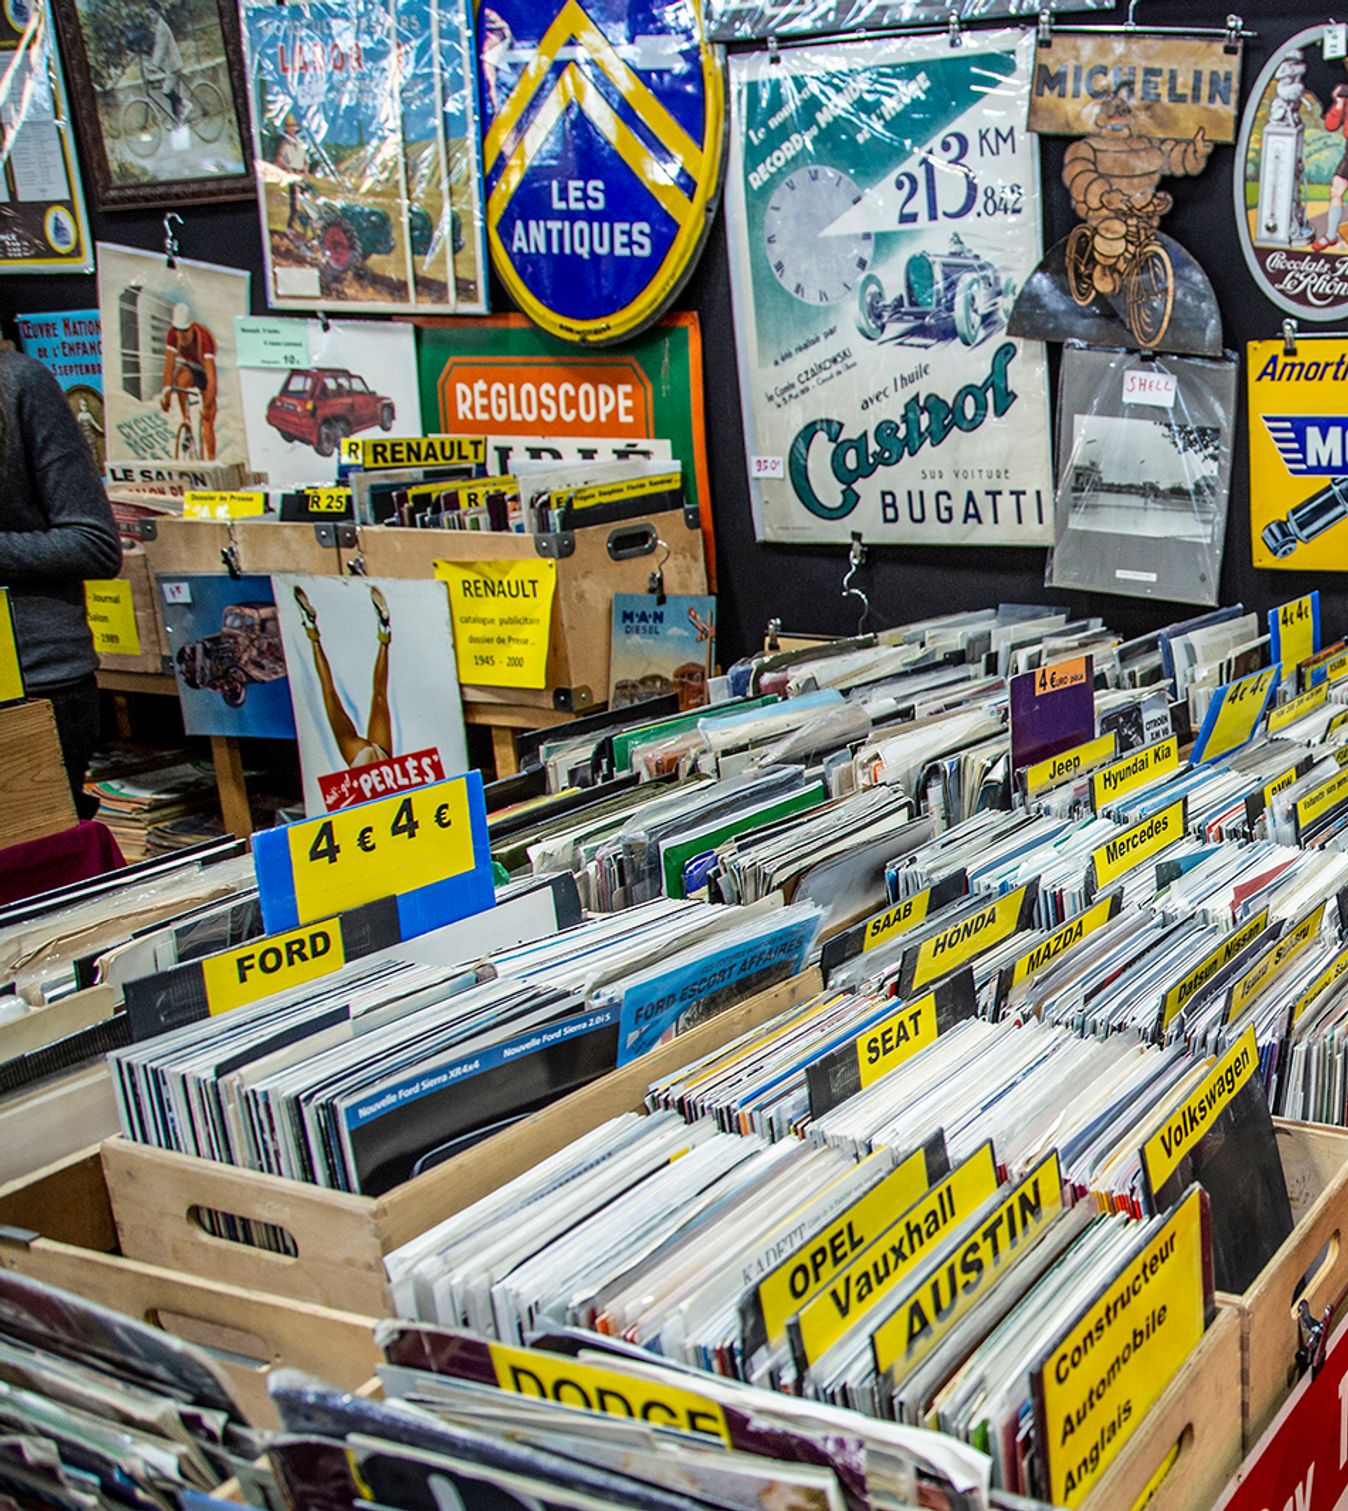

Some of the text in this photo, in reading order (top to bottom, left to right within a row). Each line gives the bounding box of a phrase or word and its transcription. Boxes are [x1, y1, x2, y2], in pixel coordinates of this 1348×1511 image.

[1035, 63, 1232, 106] MICHELIN
[748, 128, 767, 146] Le
[747, 132, 804, 191] RECORD
[894, 126, 1016, 225] 213 KM
[549, 179, 606, 212] LES
[512, 219, 652, 259] ANTIQUES
[1265, 251, 1331, 273] Chocolats
[823, 325, 838, 341] par
[454, 377, 636, 424] RÉGLOSCOPE
[861, 386, 890, 412] avec
[1126, 375, 1172, 393] SHELL
[116, 409, 170, 441] CYCLES
[788, 340, 1018, 521] Castrol
[347, 443, 359, 457] R
[372, 439, 484, 464] RENAULT
[109, 467, 135, 483] LE
[920, 468, 1011, 480] SUR VOITURE
[309, 494, 344, 510] R 25
[880, 489, 1045, 525] BUGATTI
[461, 578, 539, 599] RENAULT
[459, 614, 496, 627] catalogue
[495, 634, 506, 645] de
[624, 625, 660, 636] DIESEL
[473, 655, 524, 668] 1945 2000
[1039, 668, 1047, 691] 4
[1048, 753, 1081, 780] Jeep
[1102, 744, 1172, 793] Hyundai Kia
[308, 797, 453, 865] 4 € 4 €
[1105, 813, 1169, 866] Mercedes
[870, 900, 913, 938] SAAB
[931, 906, 997, 958] HONDA
[236, 930, 333, 986] FORD
[1025, 919, 1085, 976] MAZDA
[1177, 922, 1260, 1003] Datsun Nissan
[634, 992, 677, 1025] FORD
[681, 964, 739, 1002] ESCORT
[738, 935, 805, 977] AFFAIRES
[503, 1037, 541, 1059] Nouvelle
[541, 1026, 562, 1043] Ford
[562, 1021, 588, 1036] Sierra
[866, 1008, 923, 1065] SEAT
[357, 1059, 481, 1119] Nouvelle Ford Sierra XR4x4
[1158, 1045, 1251, 1161] Volkswagen
[788, 1220, 865, 1300] OPEL
[828, 1184, 957, 1320] Vauxhall
[905, 1176, 1046, 1354] AUSTIN
[1053, 1229, 1178, 1386] Constructeur
[1059, 1300, 1169, 1446] Automobile
[1062, 1398, 1134, 1504] Anglais
